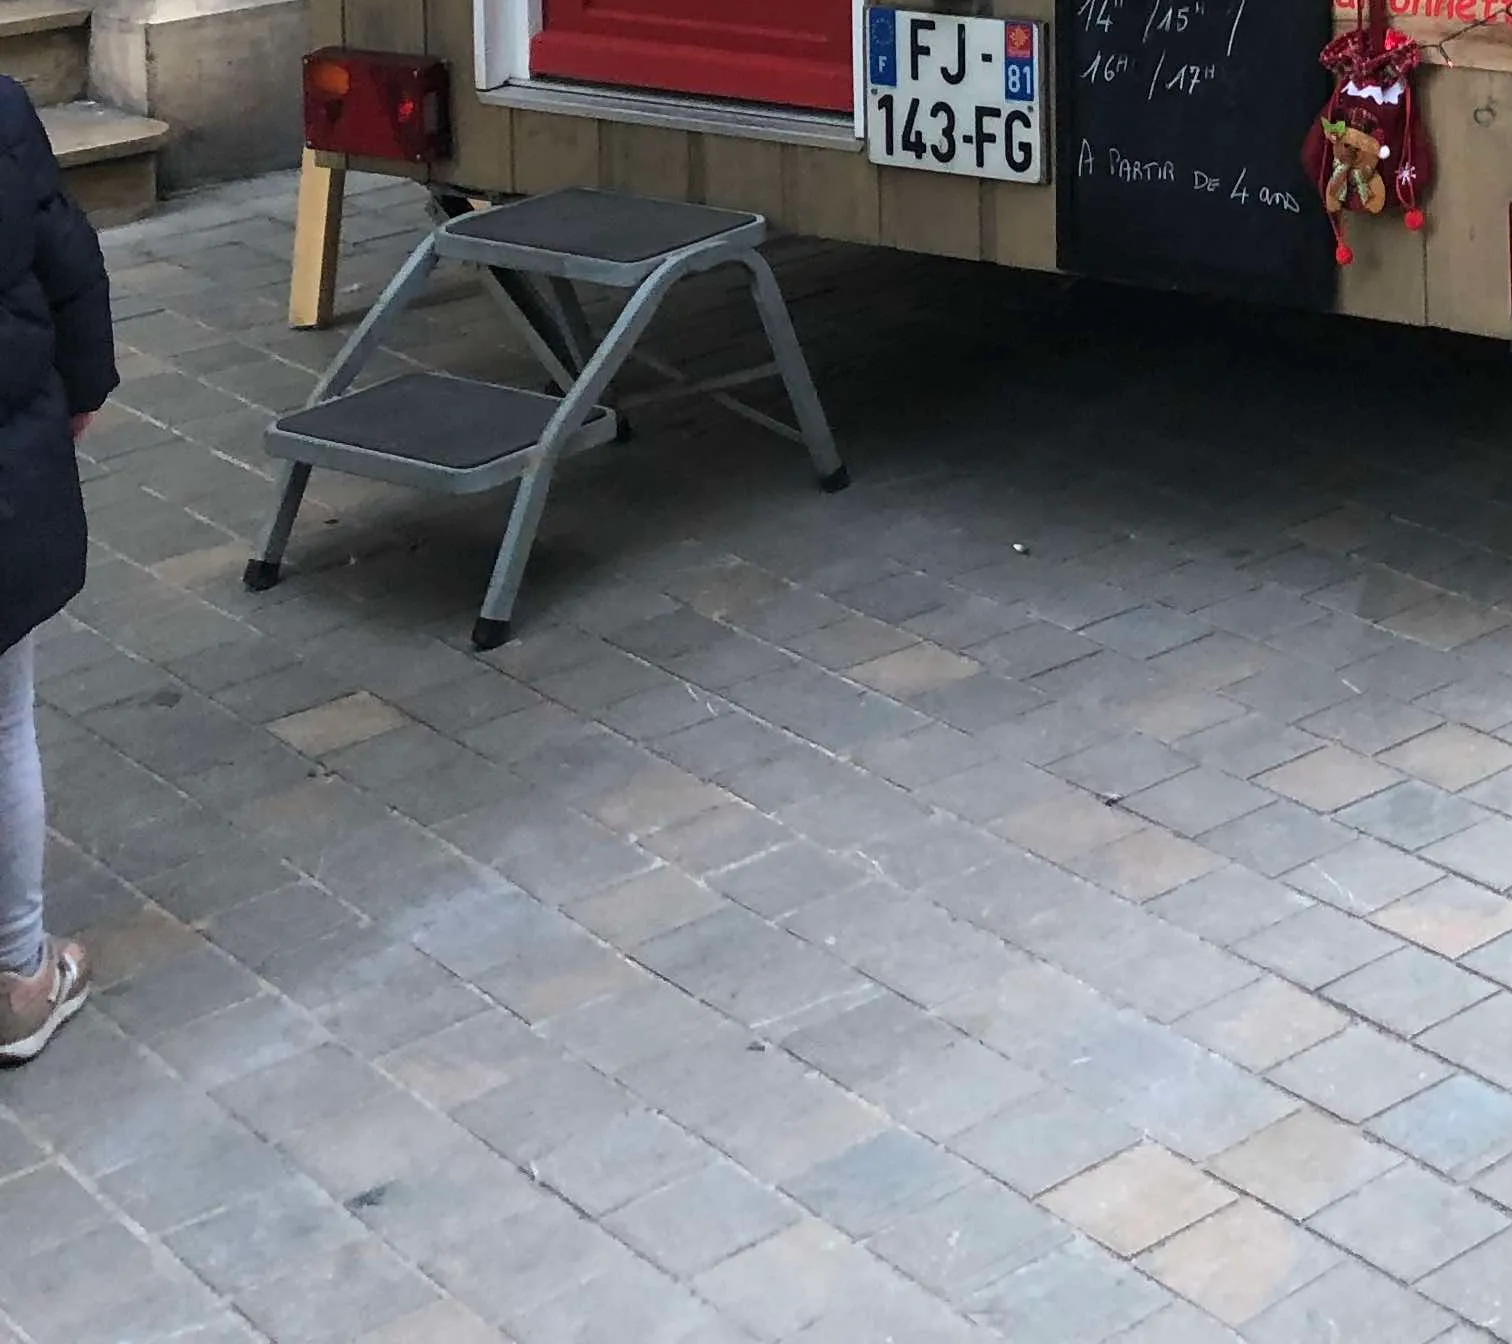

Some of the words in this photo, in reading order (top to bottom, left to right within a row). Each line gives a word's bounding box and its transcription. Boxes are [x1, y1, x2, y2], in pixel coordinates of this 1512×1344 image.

[878, 55, 888, 73] F
[1007, 64, 1032, 95] 81
[877, 94, 1033, 173] 143-FG
[1078, 138, 1095, 177] A
[1193, 170, 1220, 192] DE
[1230, 167, 1249, 204] 4
